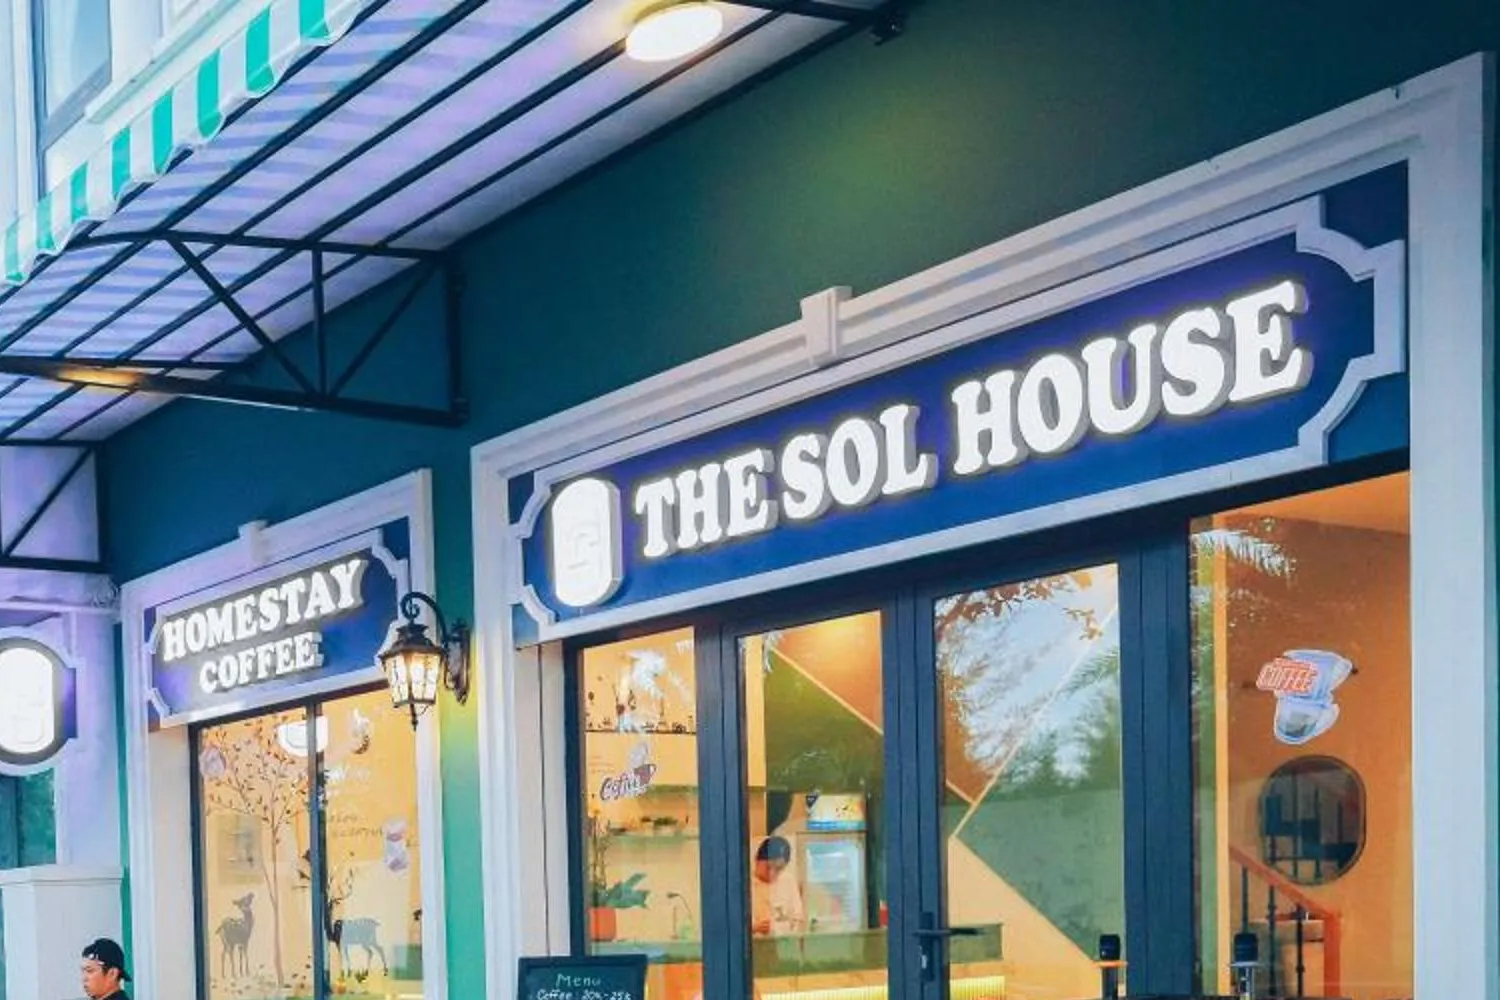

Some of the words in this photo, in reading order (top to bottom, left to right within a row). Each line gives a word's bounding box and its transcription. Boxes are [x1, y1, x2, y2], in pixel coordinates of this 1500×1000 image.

[635, 448, 777, 559] THE
[781, 403, 938, 519] SOL
[952, 280, 1314, 476] HOUSE
[162, 559, 367, 662] HOMESTAY
[199, 631, 323, 694] COFFEE
[556, 973, 601, 987] Menu
